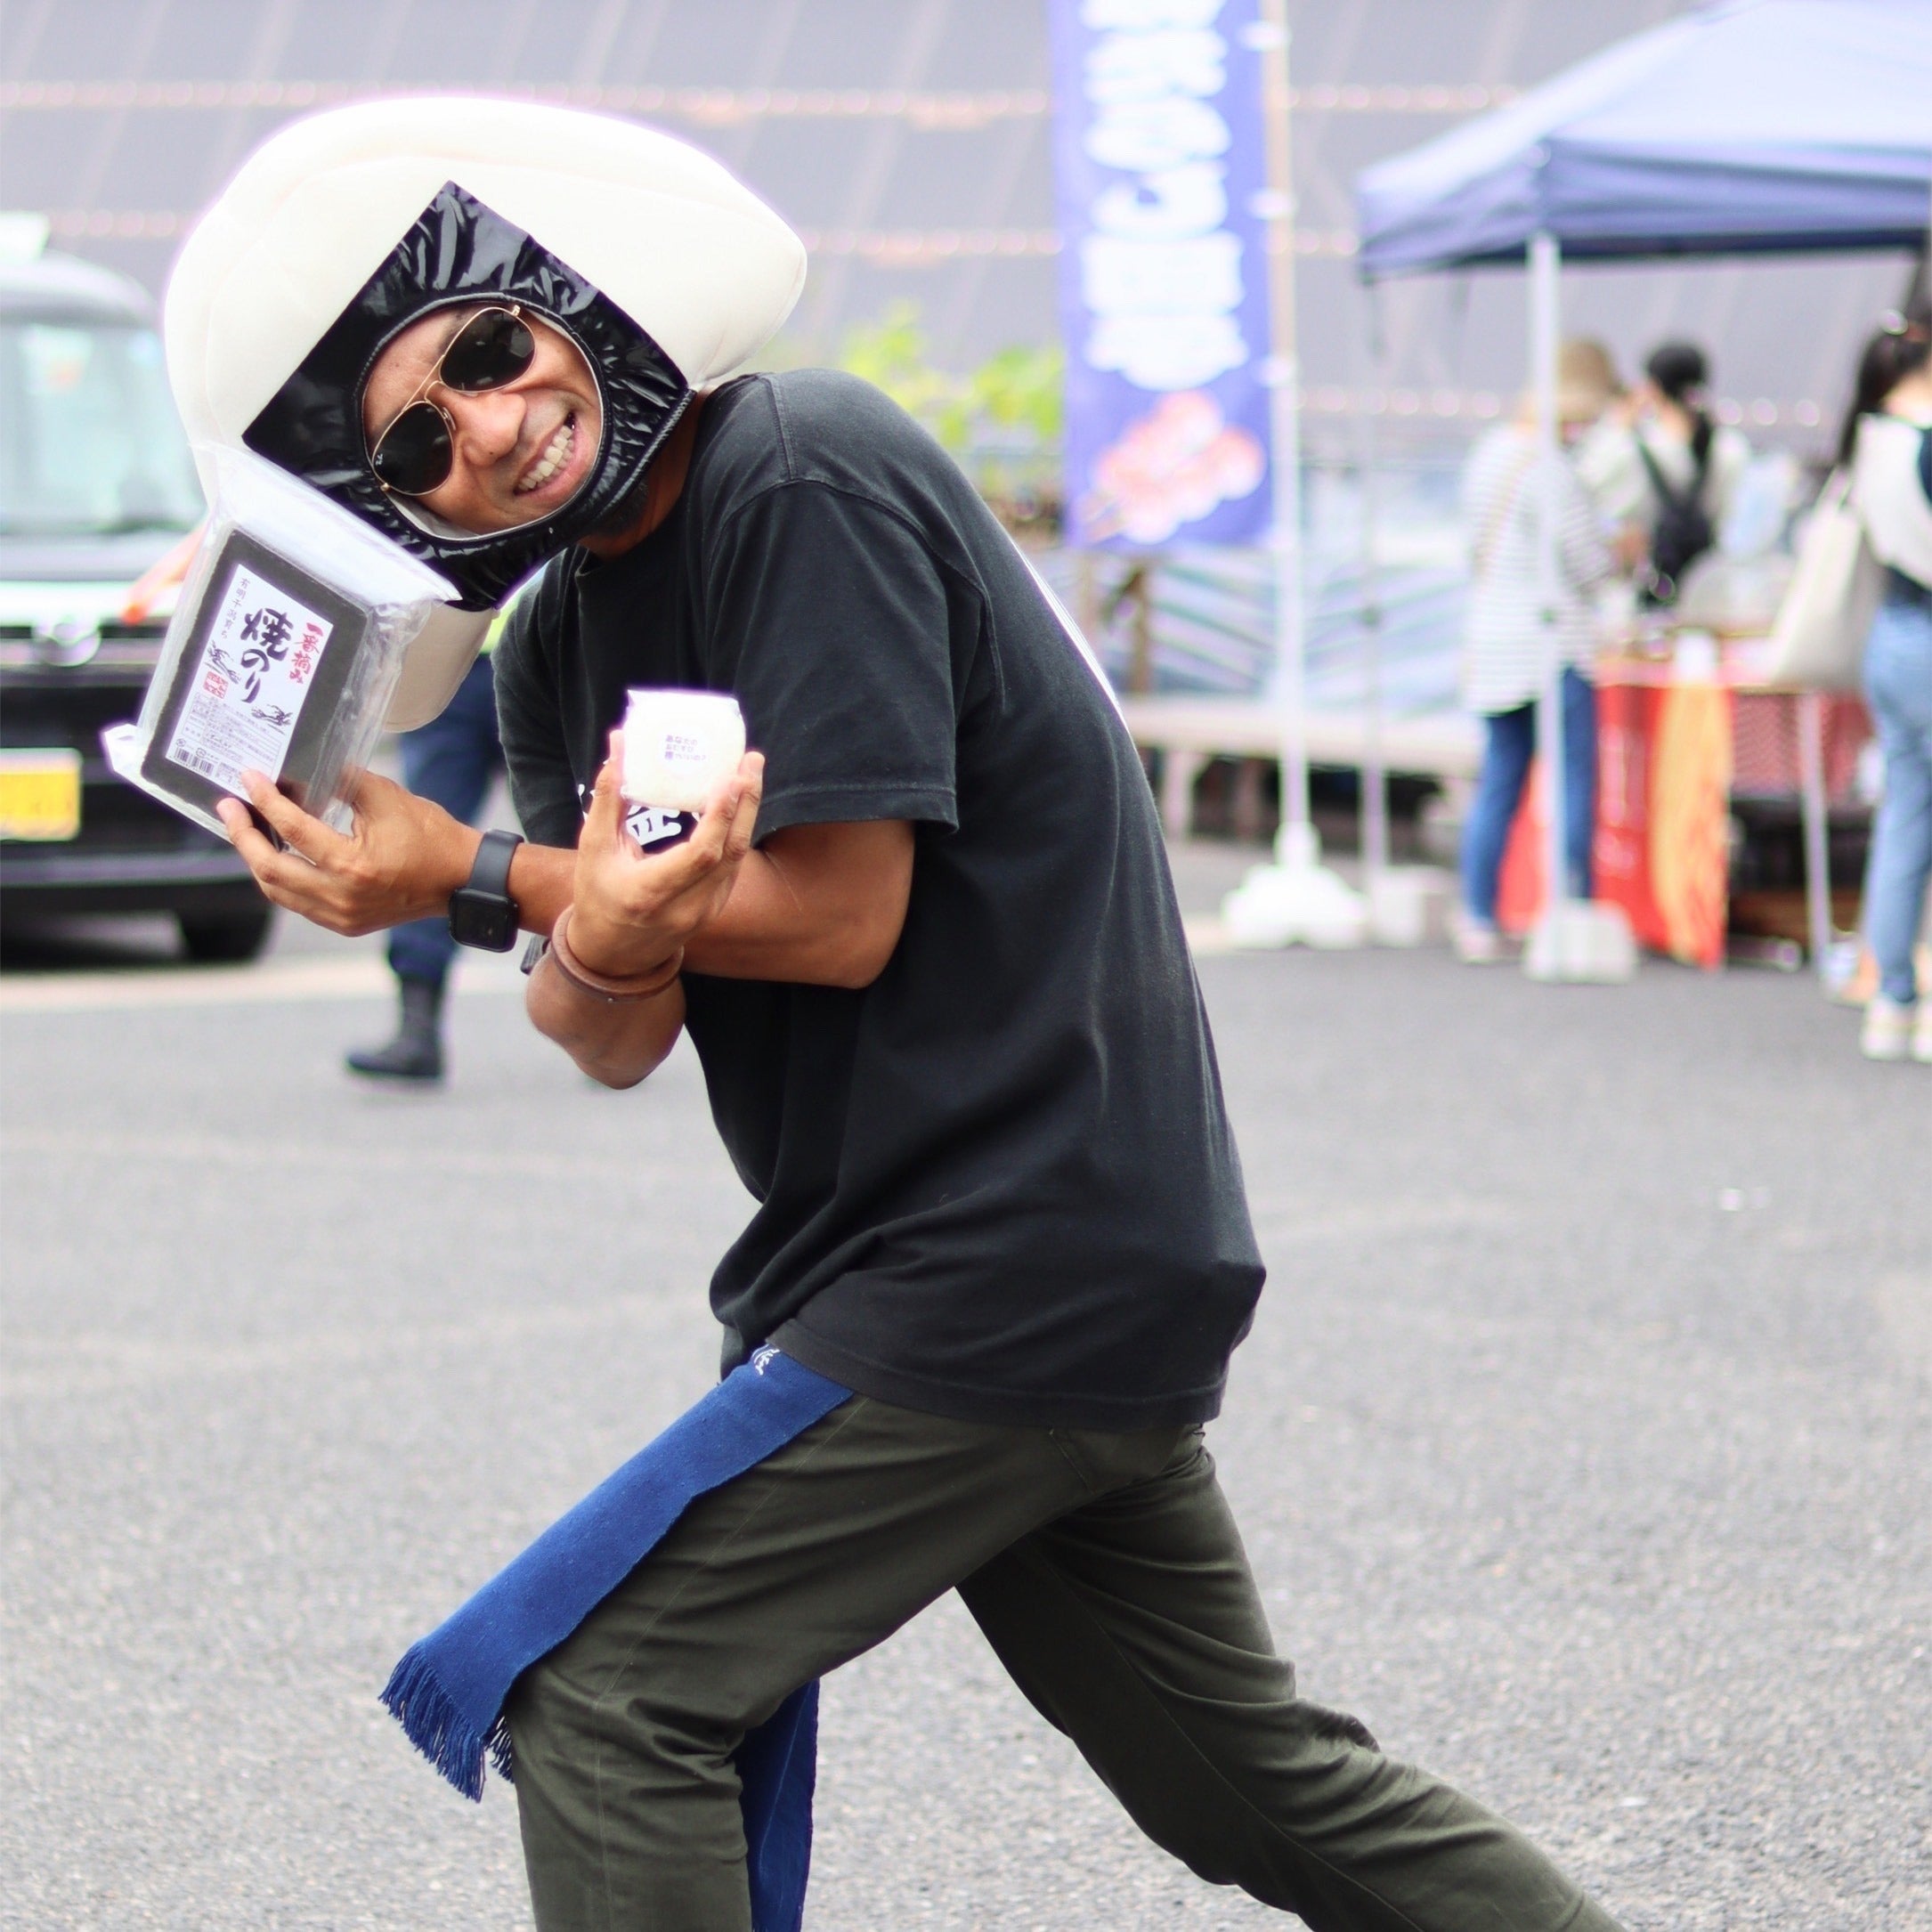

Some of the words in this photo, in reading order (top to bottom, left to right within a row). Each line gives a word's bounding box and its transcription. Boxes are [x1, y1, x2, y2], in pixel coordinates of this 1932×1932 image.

[239, 607, 294, 703] 焼のり
[289, 621, 324, 685] 一番摘み
